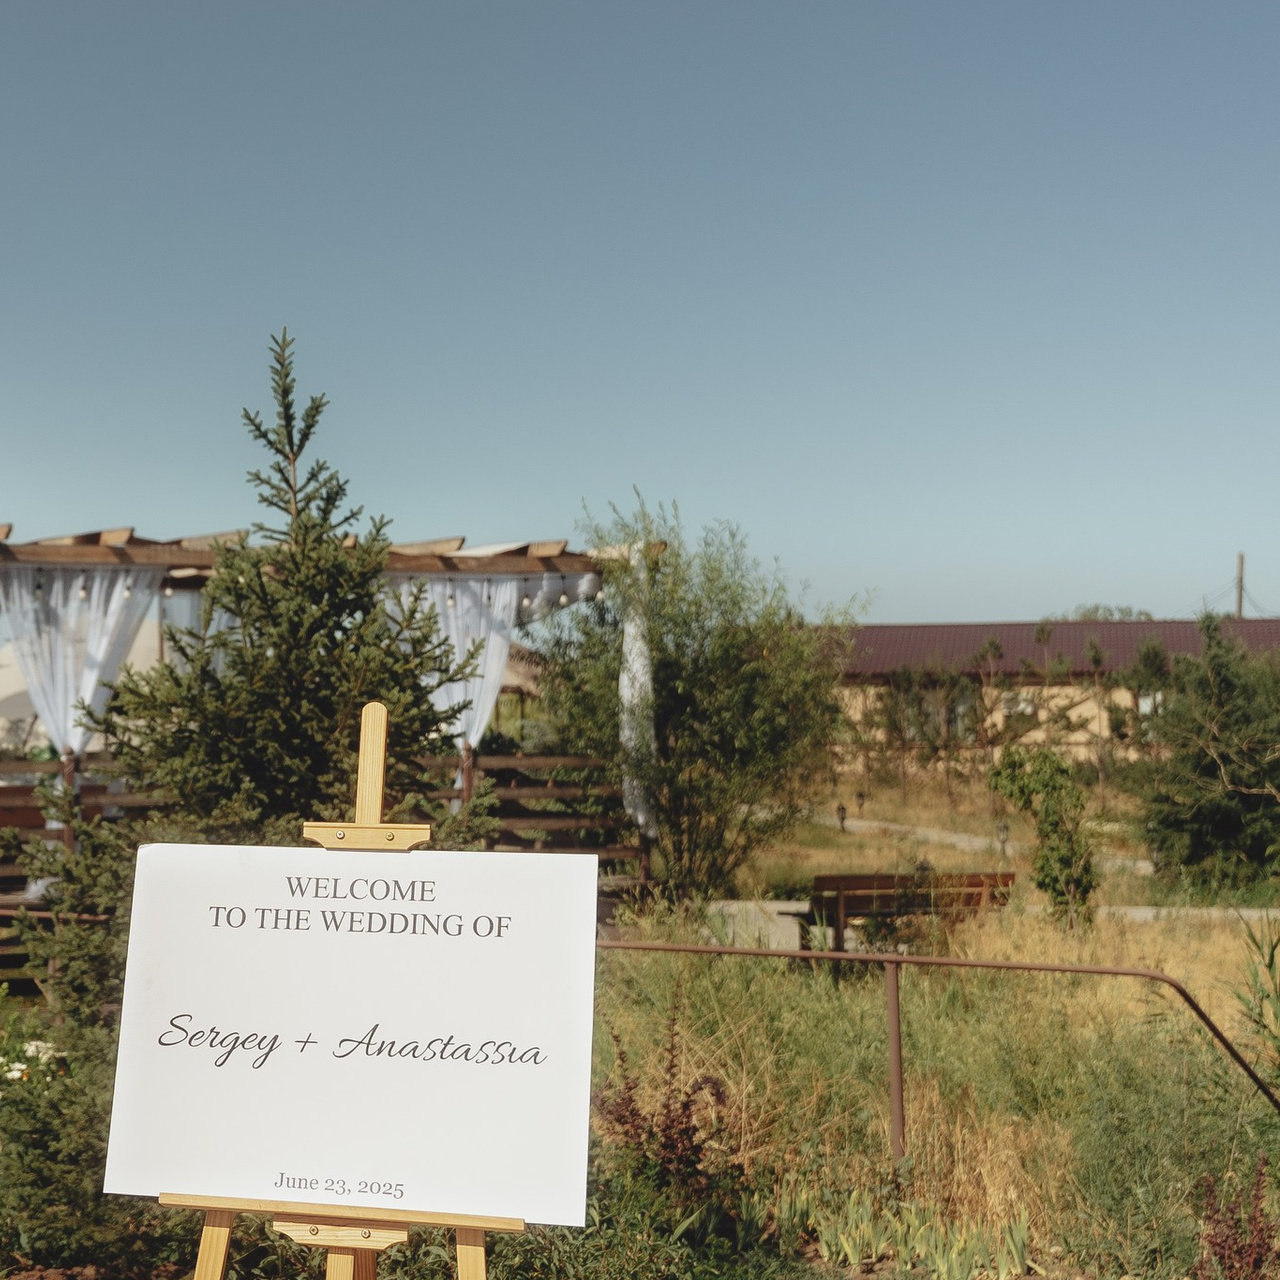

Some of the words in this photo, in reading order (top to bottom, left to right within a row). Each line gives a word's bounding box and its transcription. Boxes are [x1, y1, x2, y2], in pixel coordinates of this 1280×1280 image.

[285, 876, 437, 902] WELCOME
[208, 906, 247, 929] TO
[254, 907, 312, 931] THE
[319, 910, 464, 937] WEDDING
[472, 915, 512, 938] OF
[157, 1013, 283, 1070] Sergey
[332, 1023, 548, 1065] Anastassia
[274, 1172, 319, 1190] June
[324, 1178, 352, 1195] 23,
[358, 1180, 404, 1200] 2025
